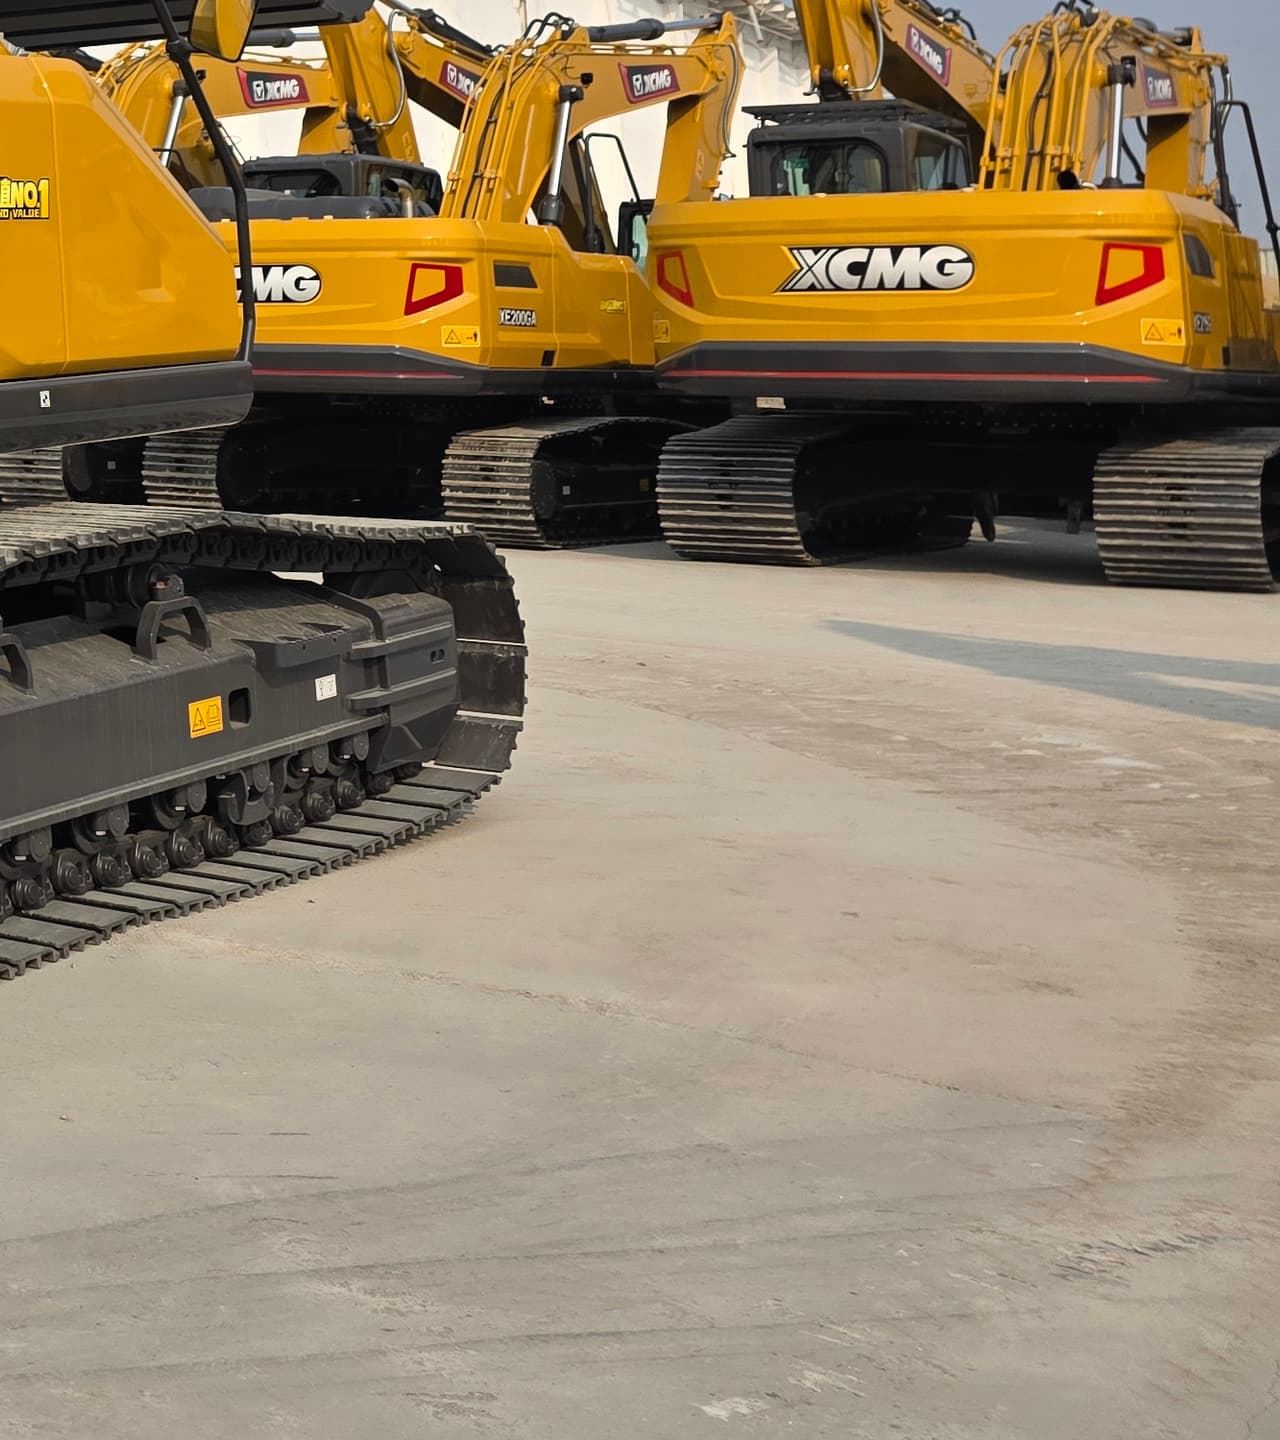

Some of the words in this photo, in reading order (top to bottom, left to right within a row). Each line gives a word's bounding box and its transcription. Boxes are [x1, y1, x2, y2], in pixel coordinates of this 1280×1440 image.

[265, 78, 300, 101] XCMG
[643, 68, 672, 94] XCMG
[12, 209, 40, 218] VALUE
[784, 245, 973, 289] XCMG
[234, 265, 321, 302] MG
